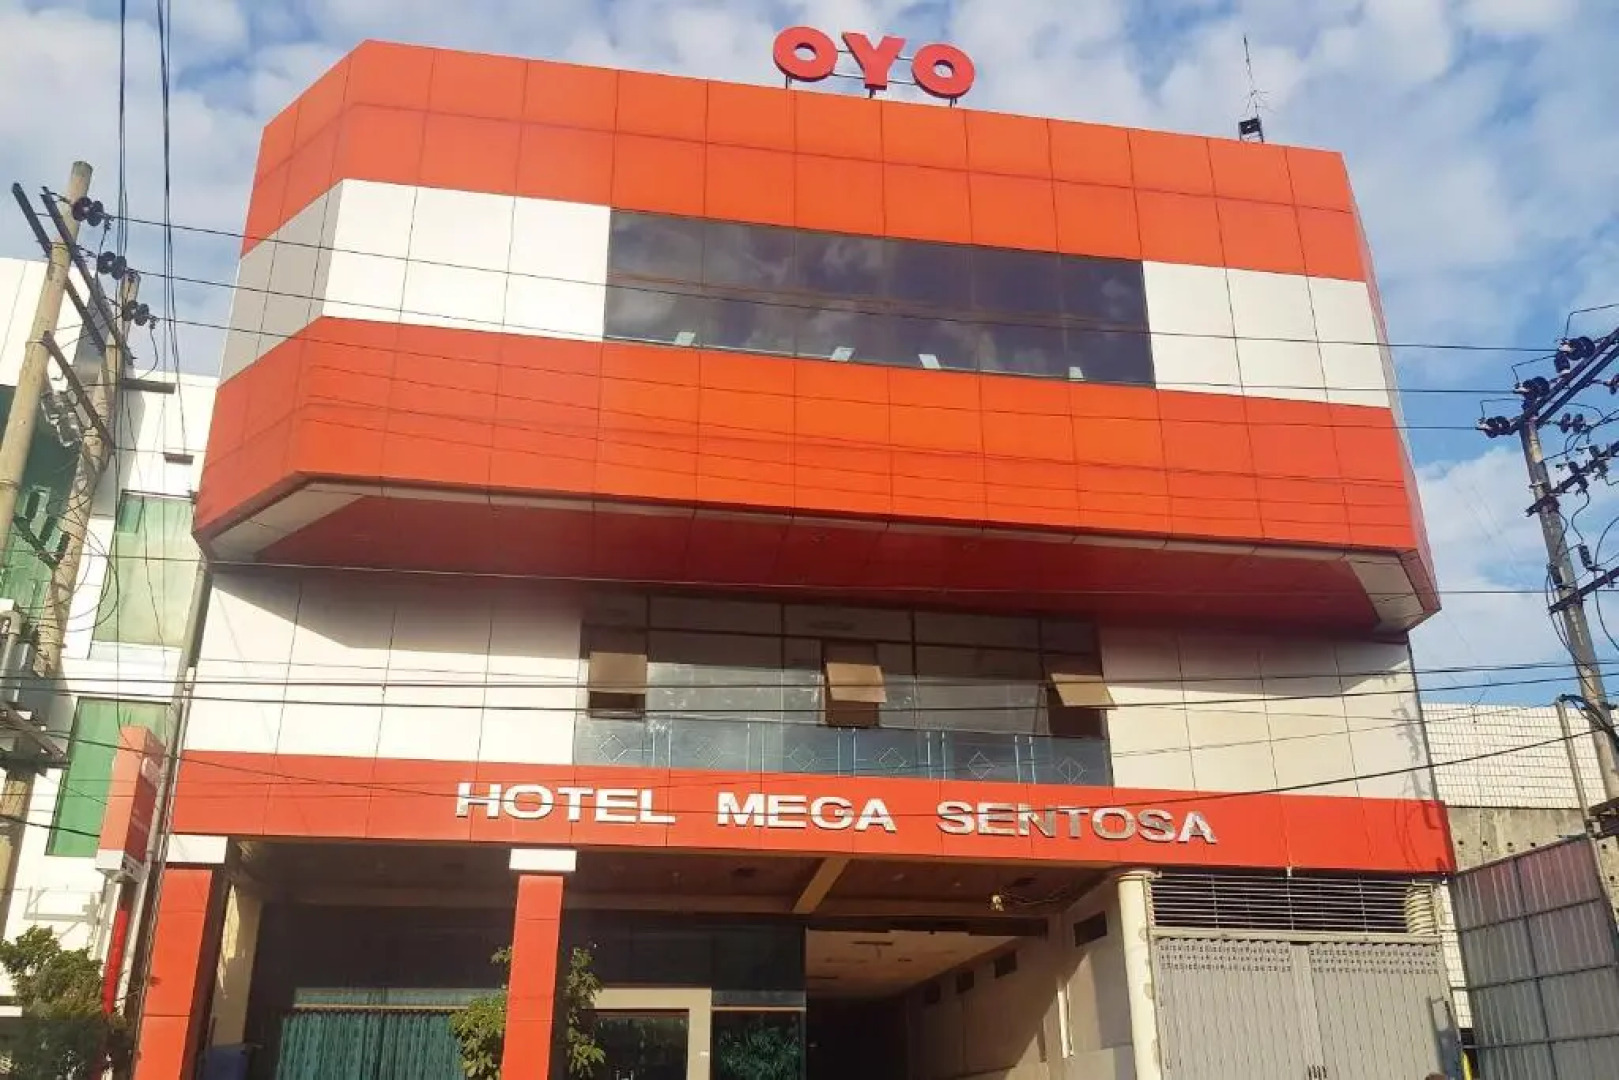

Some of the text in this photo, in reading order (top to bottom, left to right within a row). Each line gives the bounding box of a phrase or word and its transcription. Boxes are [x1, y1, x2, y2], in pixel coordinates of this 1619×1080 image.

[773, 26, 975, 98] OYO
[455, 781, 1218, 844] HOTEL MEGA SENTOSA
